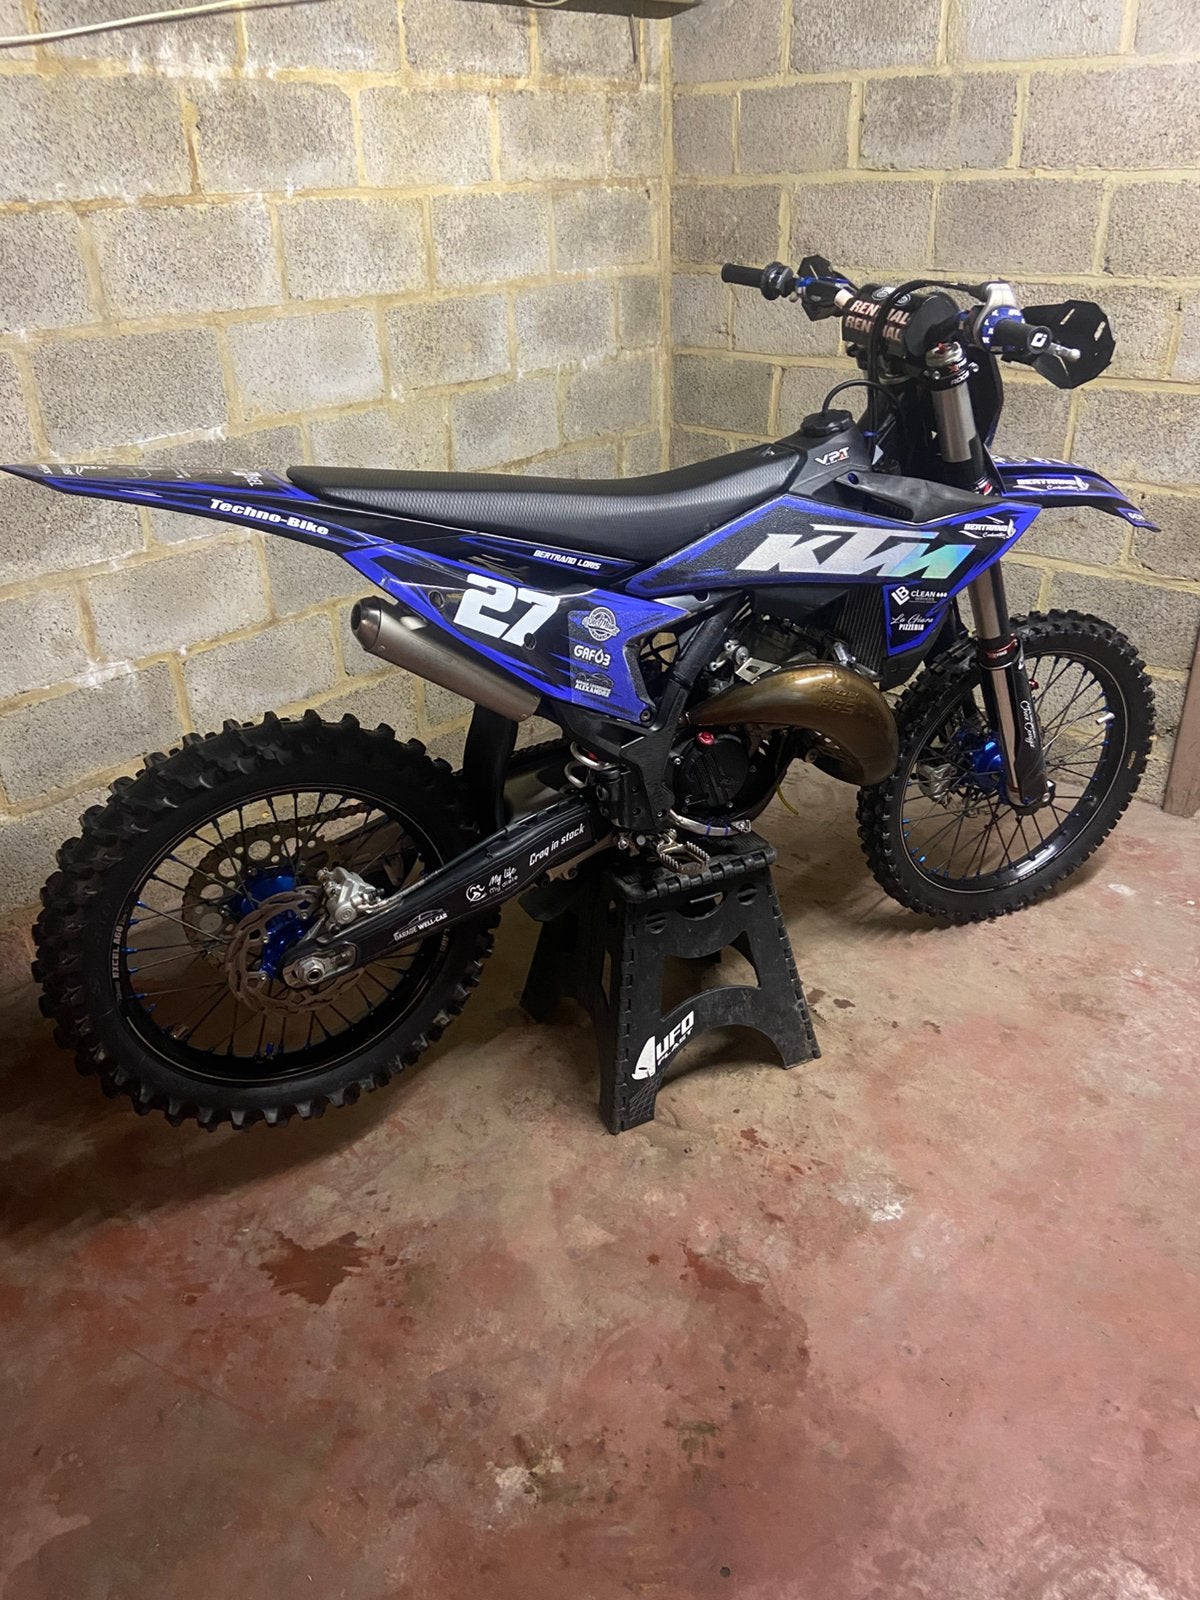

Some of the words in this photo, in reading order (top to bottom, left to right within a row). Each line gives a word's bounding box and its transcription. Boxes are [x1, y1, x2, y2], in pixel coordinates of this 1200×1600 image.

[845, 315, 902, 341] RENAL
[850, 300, 910, 324] RENAL
[210, 498, 329, 536] Techno-Bike
[533, 549, 577, 565] BERTRAND
[577, 559, 602, 570] LORIS
[735, 523, 976, 580] KTM
[453, 573, 561, 648] 27
[550, 840, 560, 851] in
[560, 823, 585, 845] stock
[656, 1010, 694, 1060] UFO
